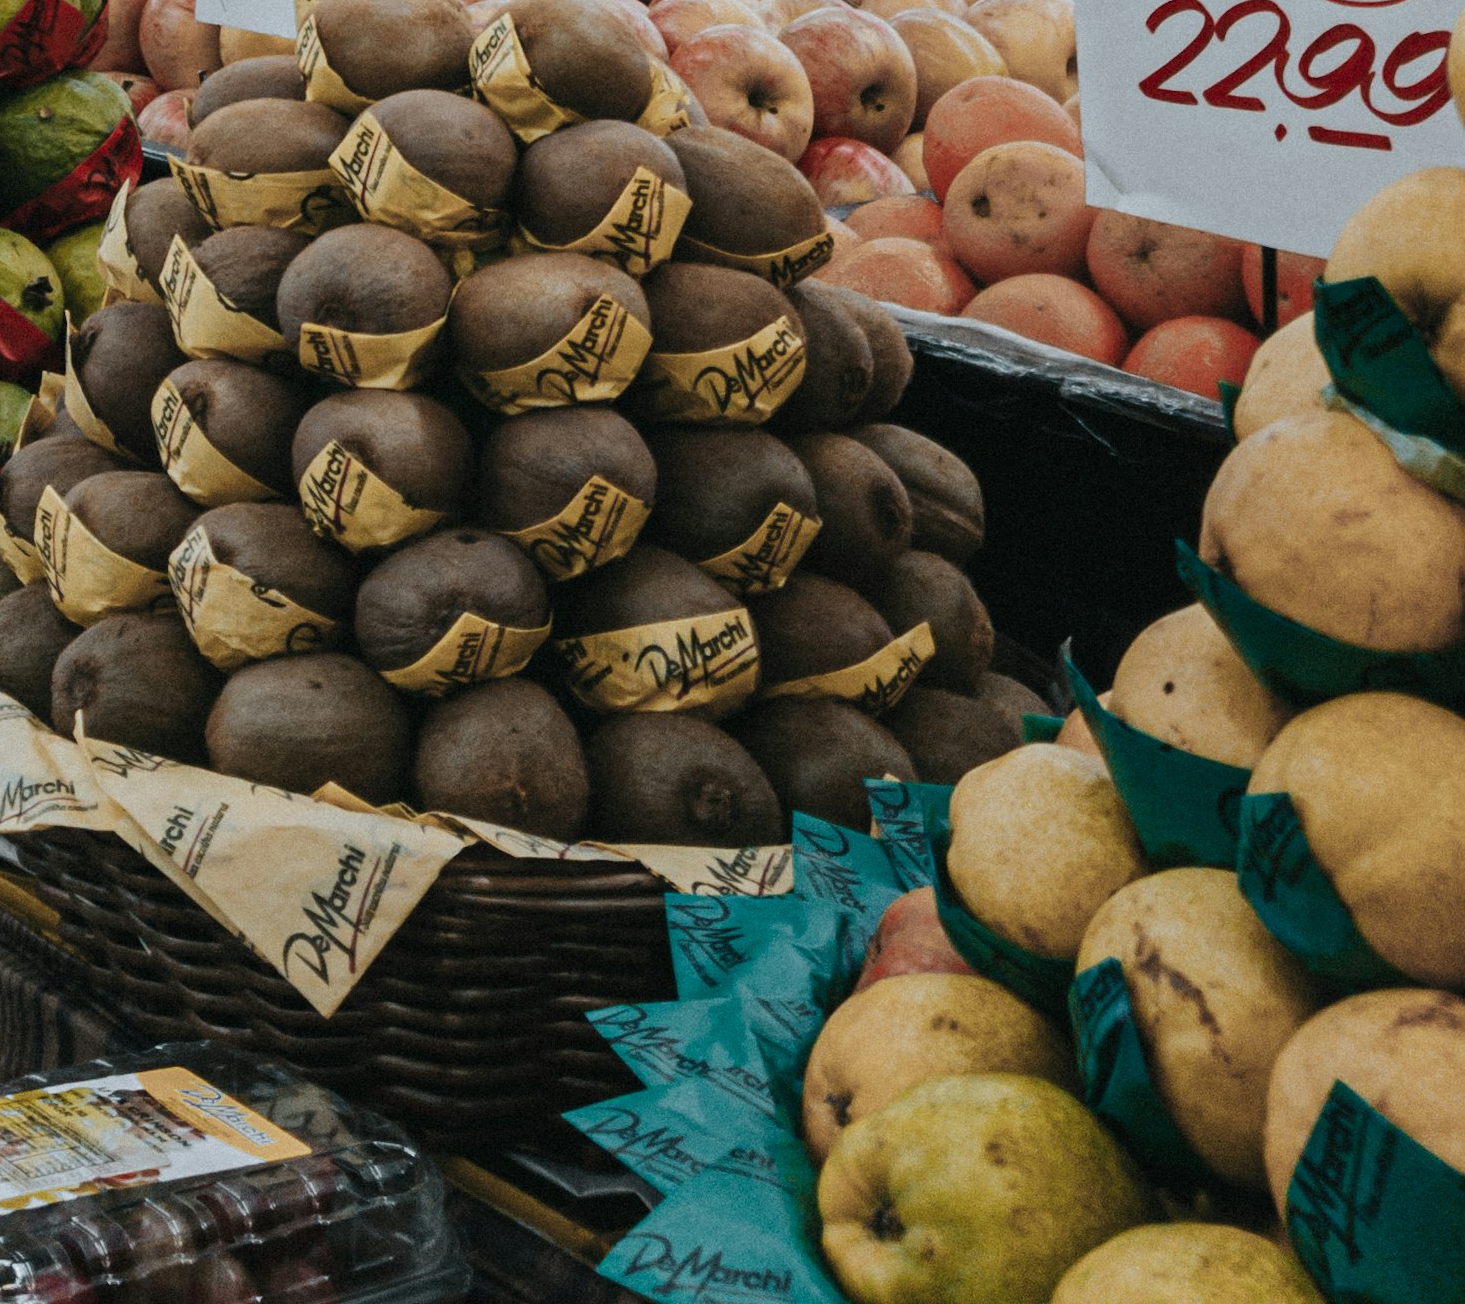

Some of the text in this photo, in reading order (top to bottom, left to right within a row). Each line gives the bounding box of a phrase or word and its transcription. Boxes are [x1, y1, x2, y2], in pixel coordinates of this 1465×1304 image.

[537, 299, 614, 403] DeMarchi
[695, 322, 798, 412] DeMarchi
[635, 613, 748, 693] DeMarchi
[282, 843, 367, 987] DeMarchi
[626, 1230, 792, 1294] DeMarchi
